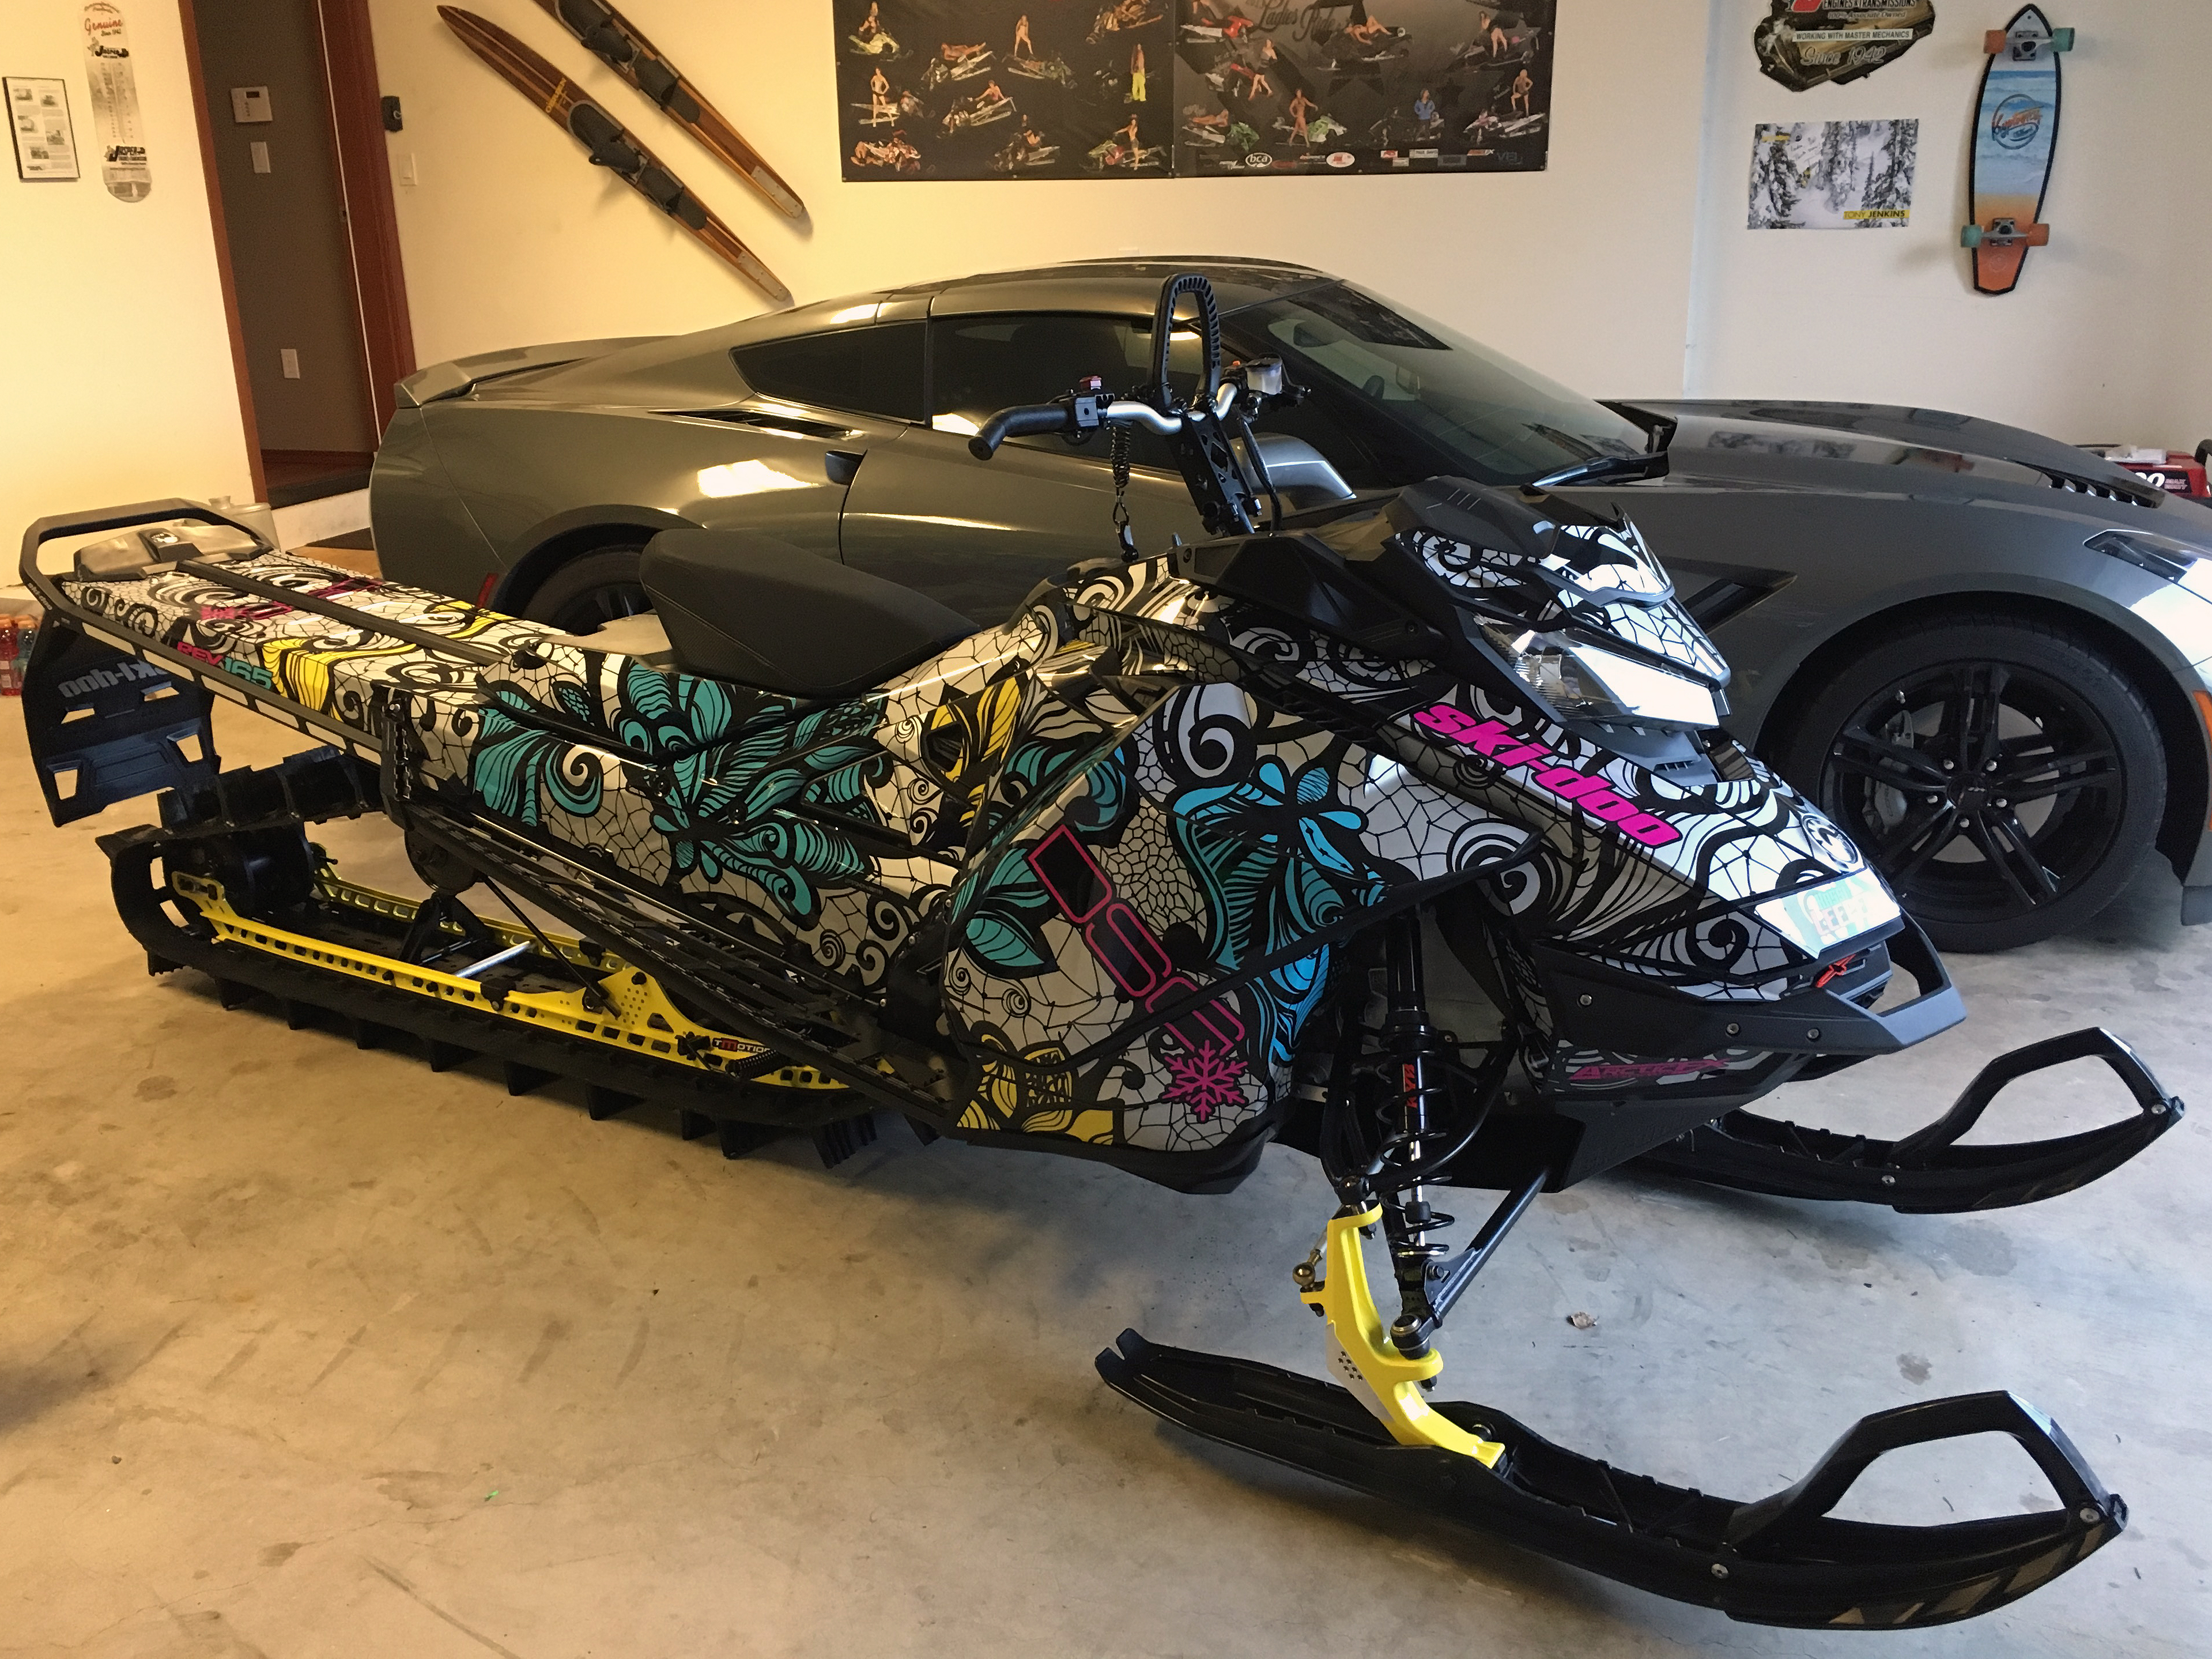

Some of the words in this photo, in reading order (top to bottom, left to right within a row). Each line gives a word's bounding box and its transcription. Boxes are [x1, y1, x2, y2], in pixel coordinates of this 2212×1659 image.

[84, 17, 123, 36] Genuine
[1796, 31, 1826, 40] WORKING
[1828, 31, 1843, 39] WITH
[1845, 31, 1871, 39] MASTER
[1872, 30, 1910, 39] MECHANICS
[1800, 46, 1841, 66] Since
[1847, 46, 1887, 65] 1942
[1250, 153, 1268, 163] bca
[1844, 211, 1866, 219] TONY
[1867, 210, 1905, 218] JENKINS
[2135, 472, 2165, 487] 0
[177, 641, 224, 665] REV
[225, 657, 273, 689] 165
[1413, 704, 1682, 847] ski-doo
